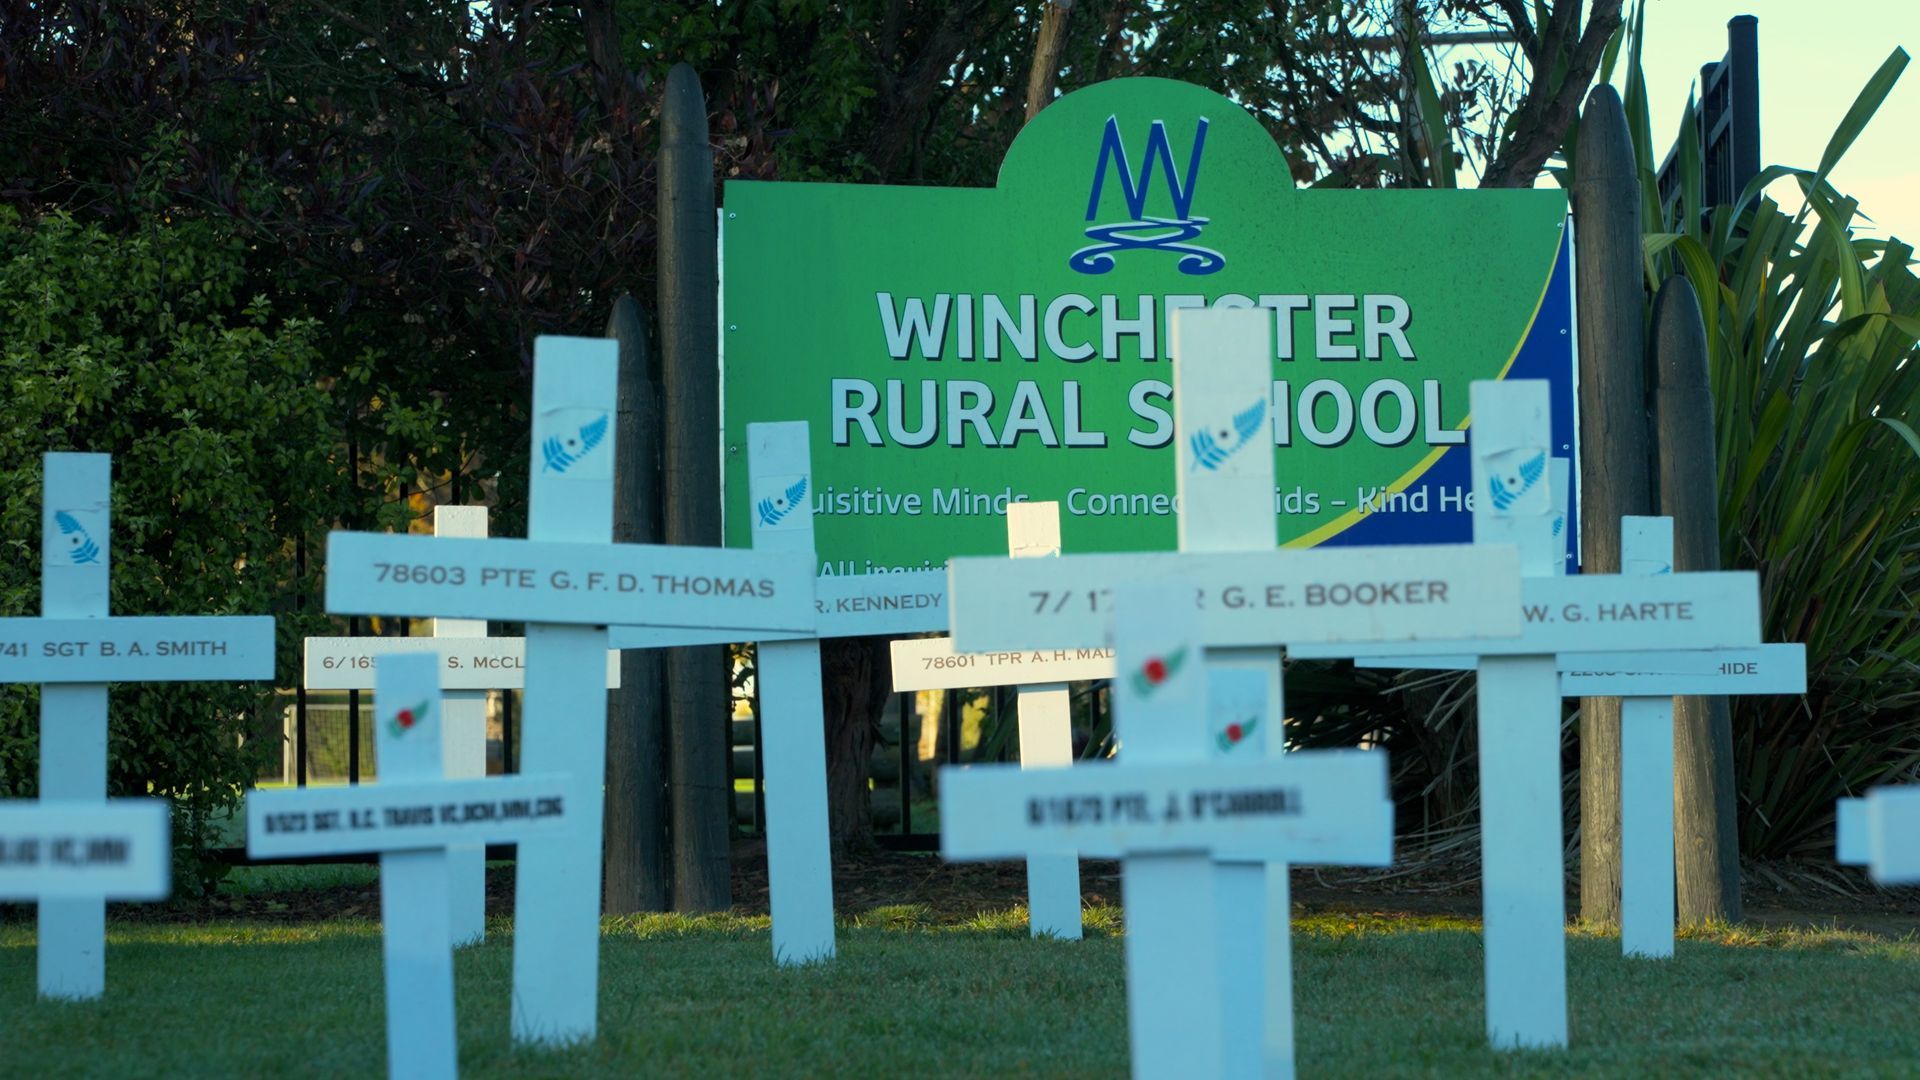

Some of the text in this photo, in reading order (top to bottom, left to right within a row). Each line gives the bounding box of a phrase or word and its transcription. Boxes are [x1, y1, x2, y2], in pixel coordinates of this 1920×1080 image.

[875, 291, 1417, 364] WINCHTER
[831, 378, 1467, 448] RURAL SOOL
[1357, 484, 1429, 514] Kind
[373, 562, 776, 599] 78603 PTE G. F. D. THOMAS
[1221, 585, 1255, 610] G.
[1265, 584, 1295, 608] E.
[1304, 580, 1450, 607] BOOKER
[836, 592, 943, 613] KENNEDY
[1562, 603, 1589, 622] G.
[1598, 601, 1694, 622] HARTE
[43, 641, 89, 657] SGT
[100, 640, 121, 657] B.
[128, 640, 149, 657] A.
[155, 640, 227, 656] SMITH
[922, 655, 976, 670] 78601
[985, 651, 1022, 666] TPR
[1031, 650, 1049, 663] A.
[1054, 648, 1072, 662] H.
